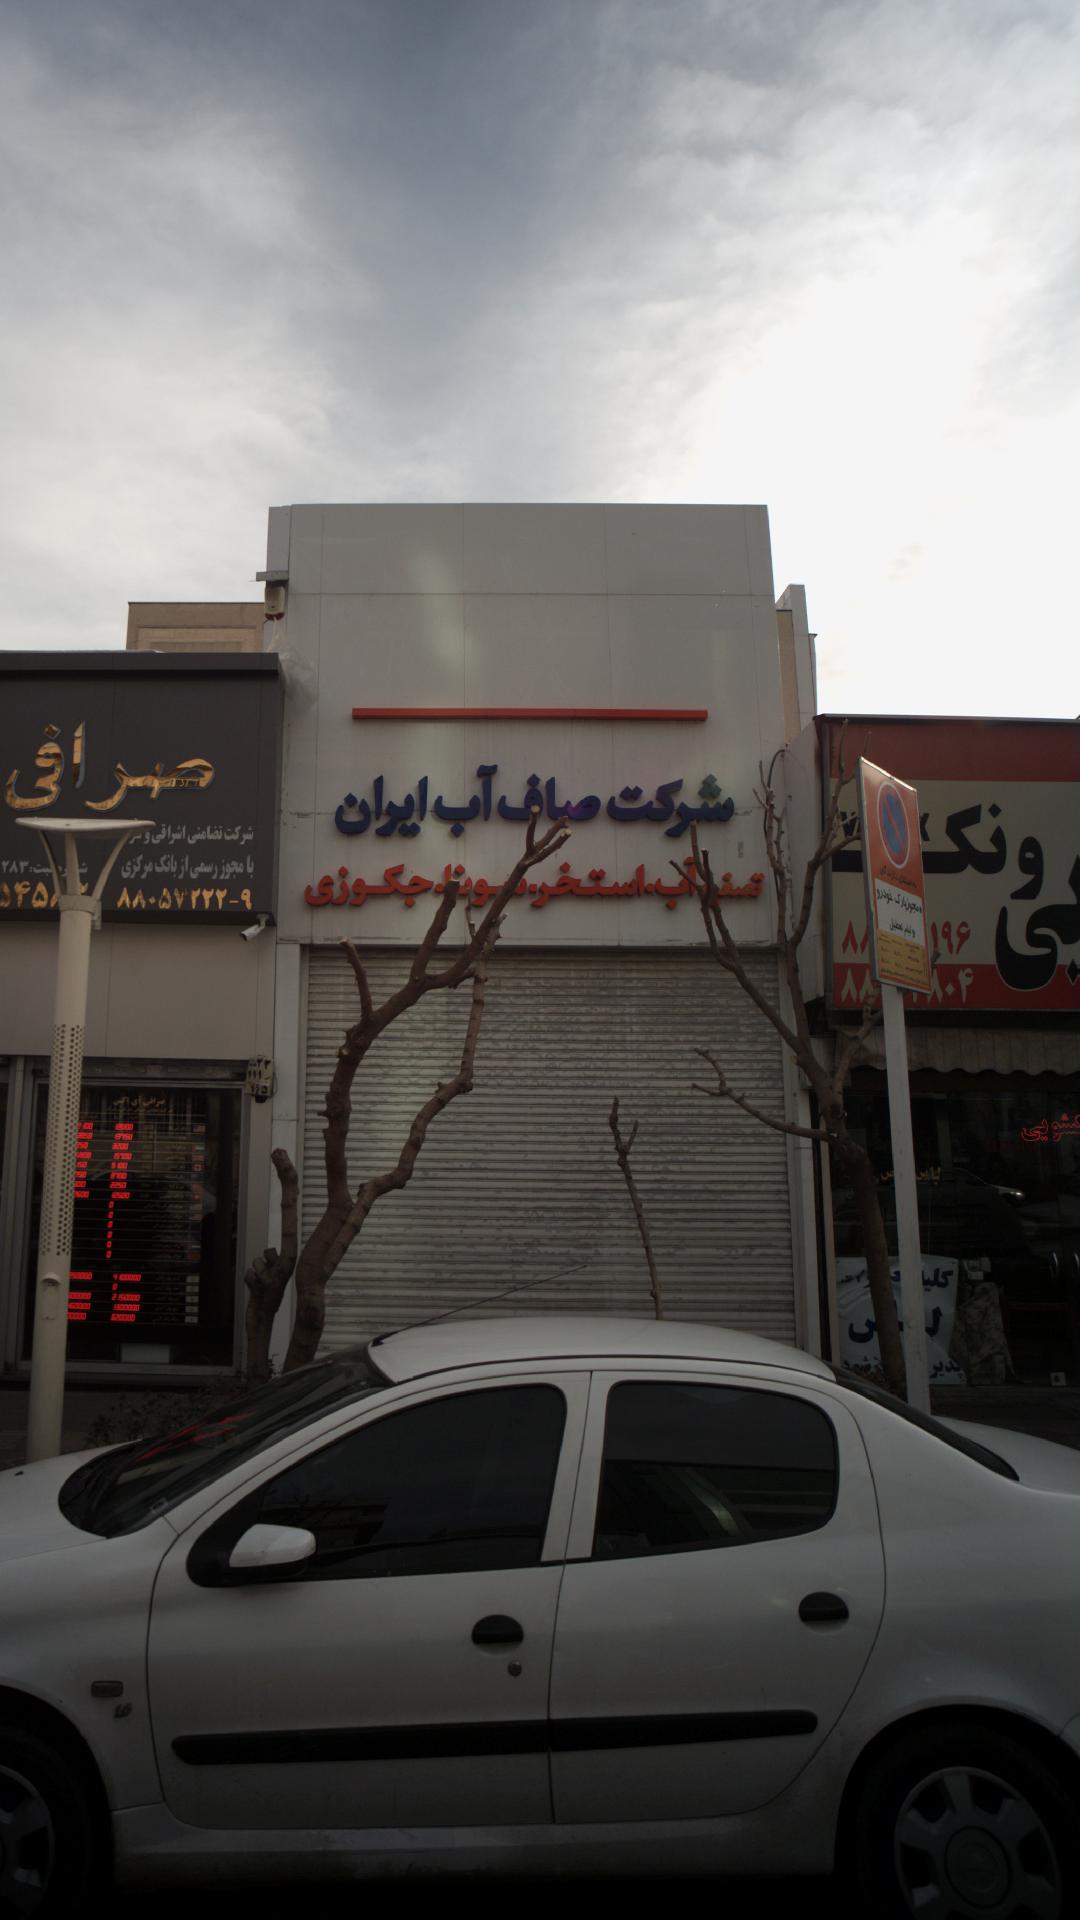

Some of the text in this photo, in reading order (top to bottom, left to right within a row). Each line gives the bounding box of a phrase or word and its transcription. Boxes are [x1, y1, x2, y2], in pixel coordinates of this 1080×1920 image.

[334, 764, 735, 837] شرکت صاف آب ایران
[143, 831, 150, 845] و
[151, 824, 186, 845] اشراقی
[187, 824, 223, 845] تضامنی
[224, 825, 254, 845] شرکت
[121, 854, 255, 880] با مجوز رسمی از بانک مرکزی
[304, 863, 433, 909] جکوزی
[529, 861, 645, 908] استخر
[654, 856, 697, 909] آب
